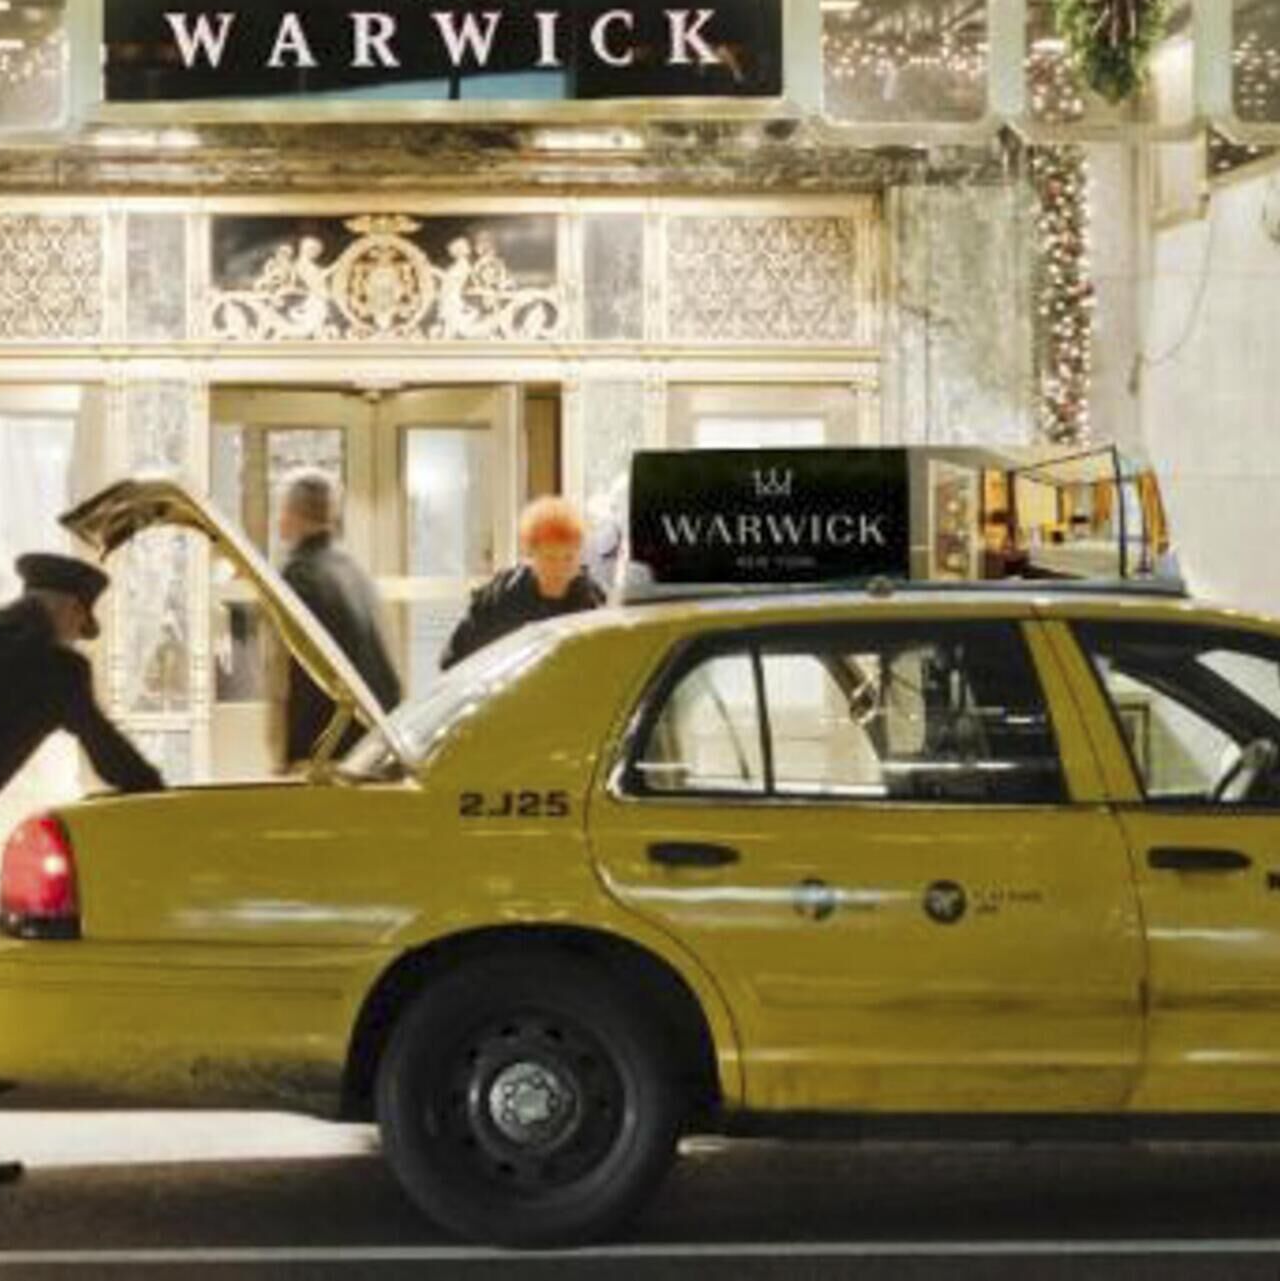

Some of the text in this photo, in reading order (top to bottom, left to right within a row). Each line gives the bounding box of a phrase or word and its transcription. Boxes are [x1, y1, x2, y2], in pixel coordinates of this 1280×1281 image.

[165, 9, 720, 68] WARWICK
[662, 515, 886, 545] WARWICK
[459, 790, 571, 817] 2J25
